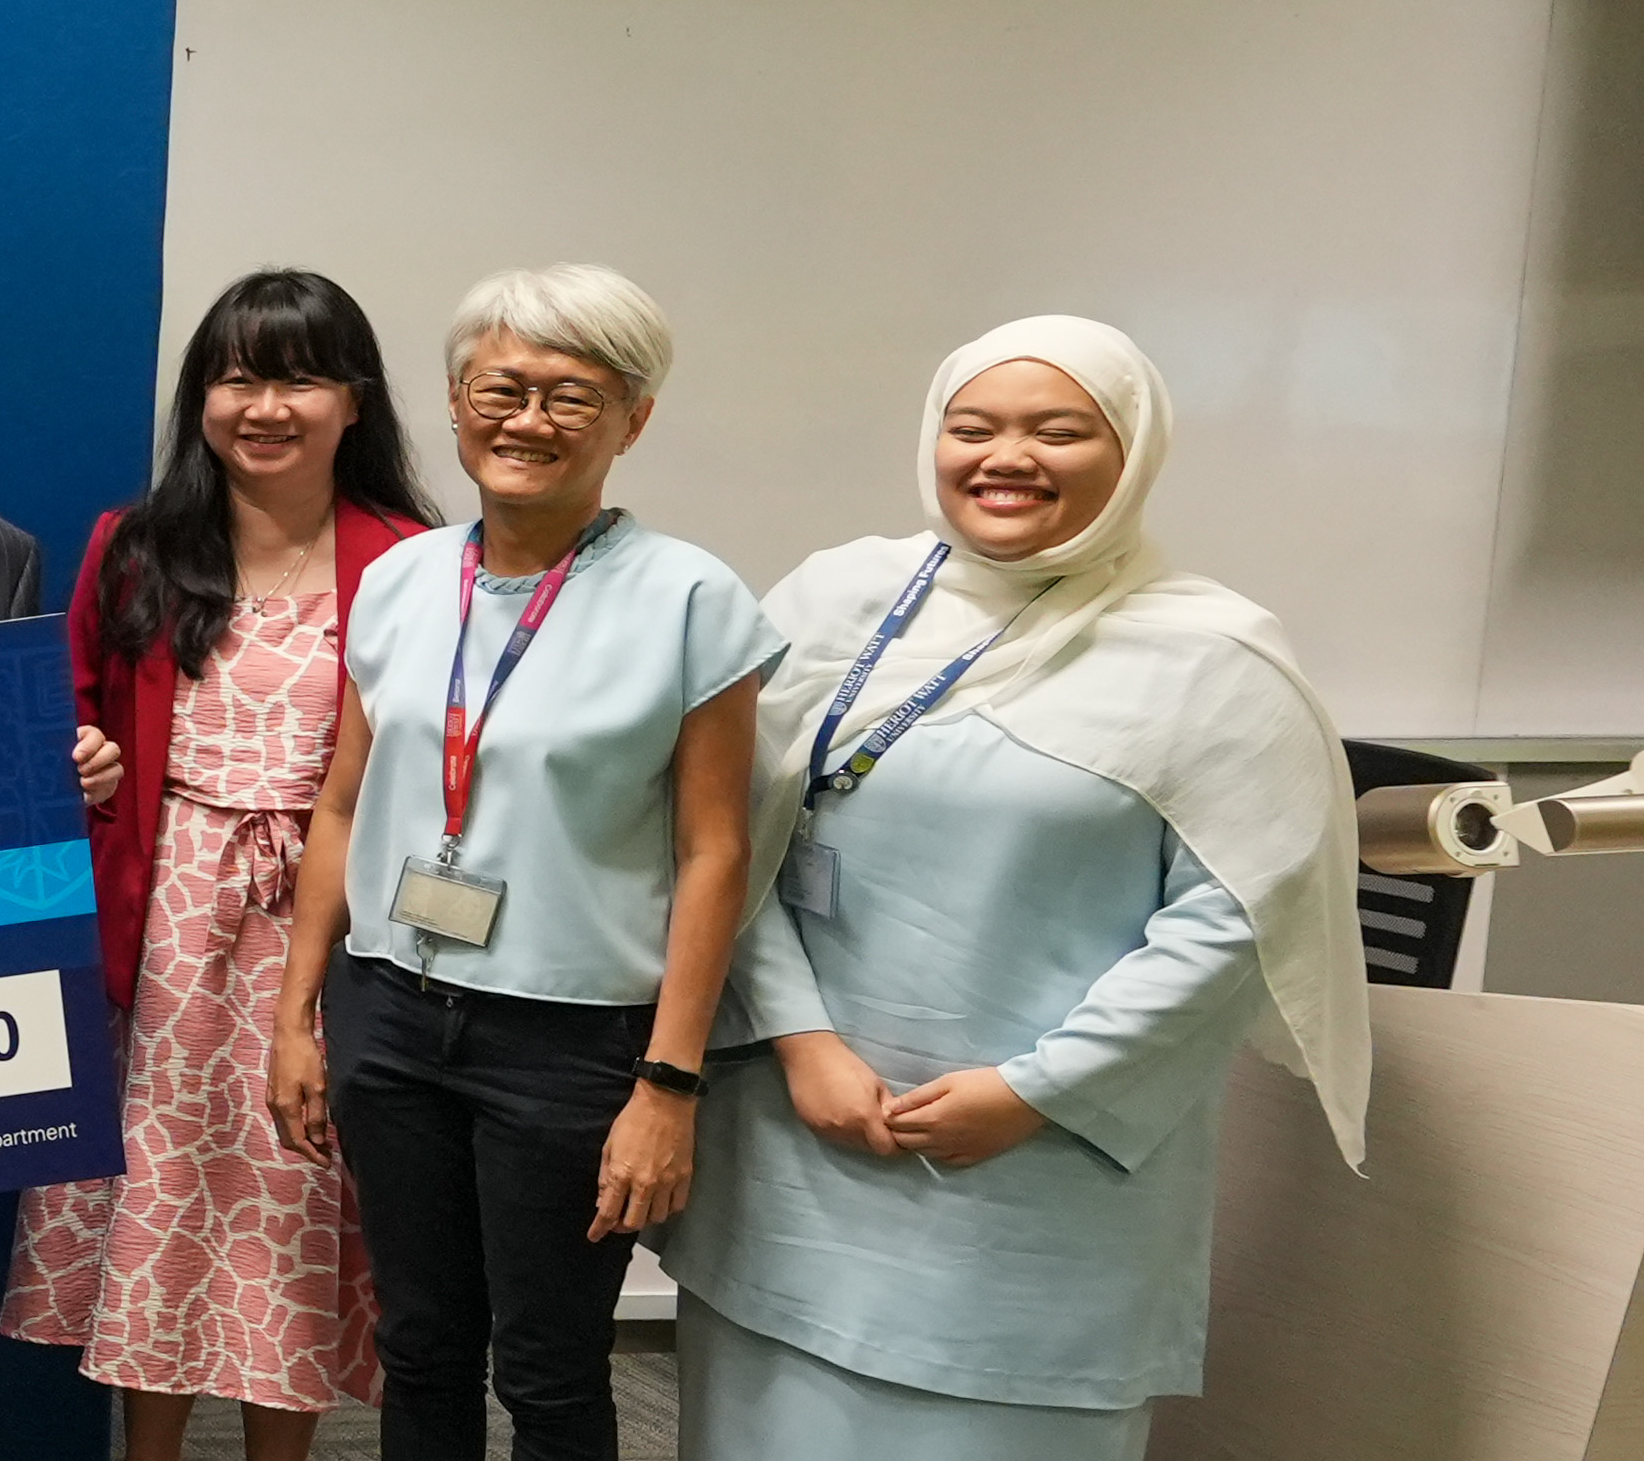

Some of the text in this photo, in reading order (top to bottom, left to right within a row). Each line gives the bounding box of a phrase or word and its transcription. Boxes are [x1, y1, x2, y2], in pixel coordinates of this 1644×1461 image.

[892, 544, 950, 618] Shaping Futures
[876, 671, 947, 739] HERIOT WATT
[885, 704, 927, 743] UNIVERSITY
